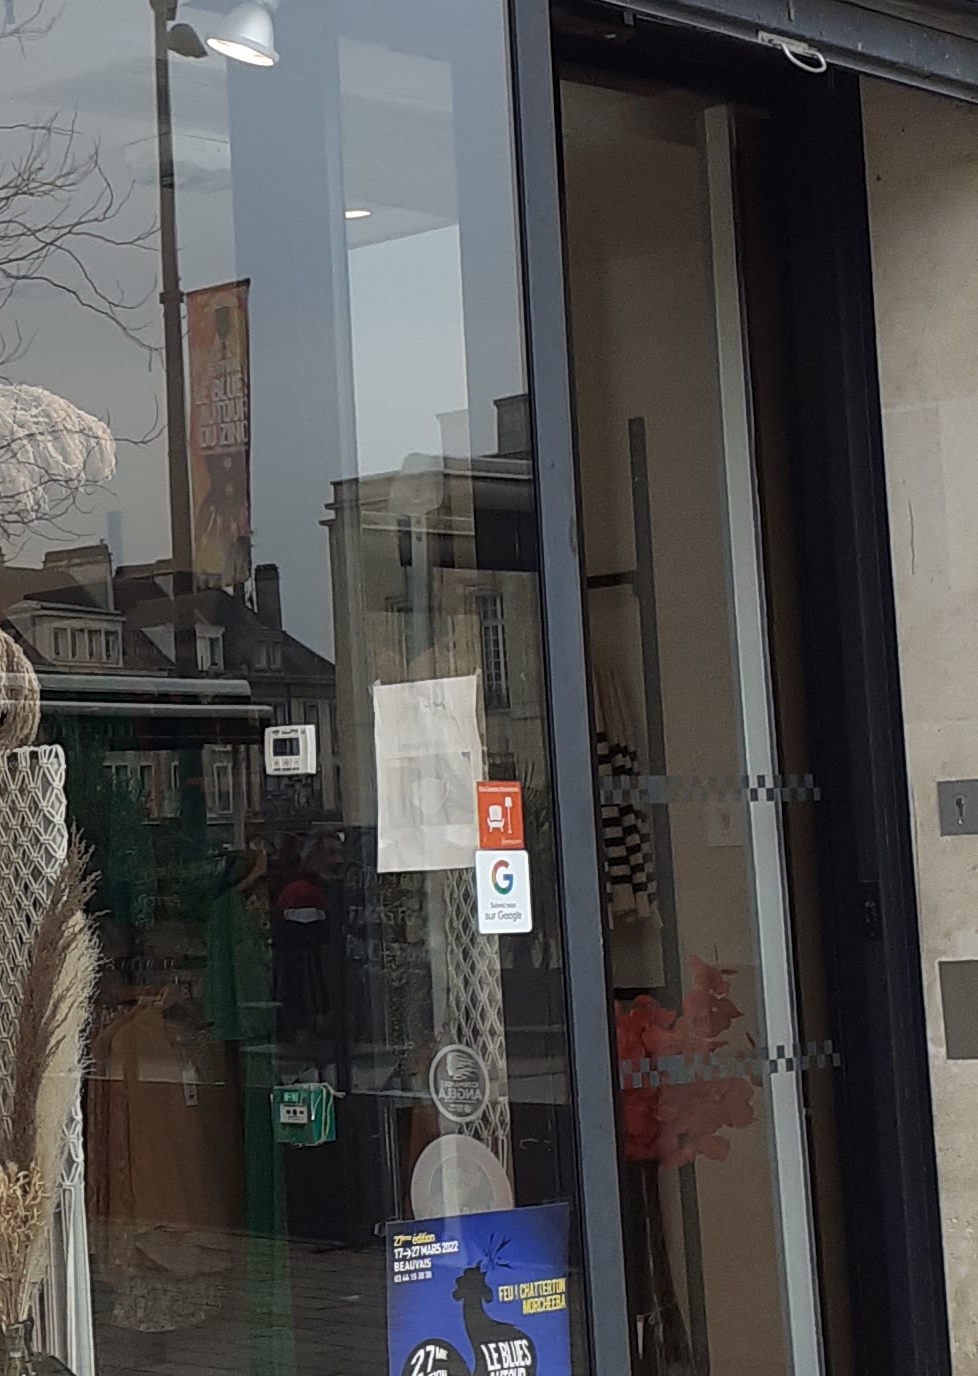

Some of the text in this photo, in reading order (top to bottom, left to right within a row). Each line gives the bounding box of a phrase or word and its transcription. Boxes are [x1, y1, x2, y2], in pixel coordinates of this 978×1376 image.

[497, 910, 522, 922] Google
[481, 1339, 532, 1372] LE BLUES
